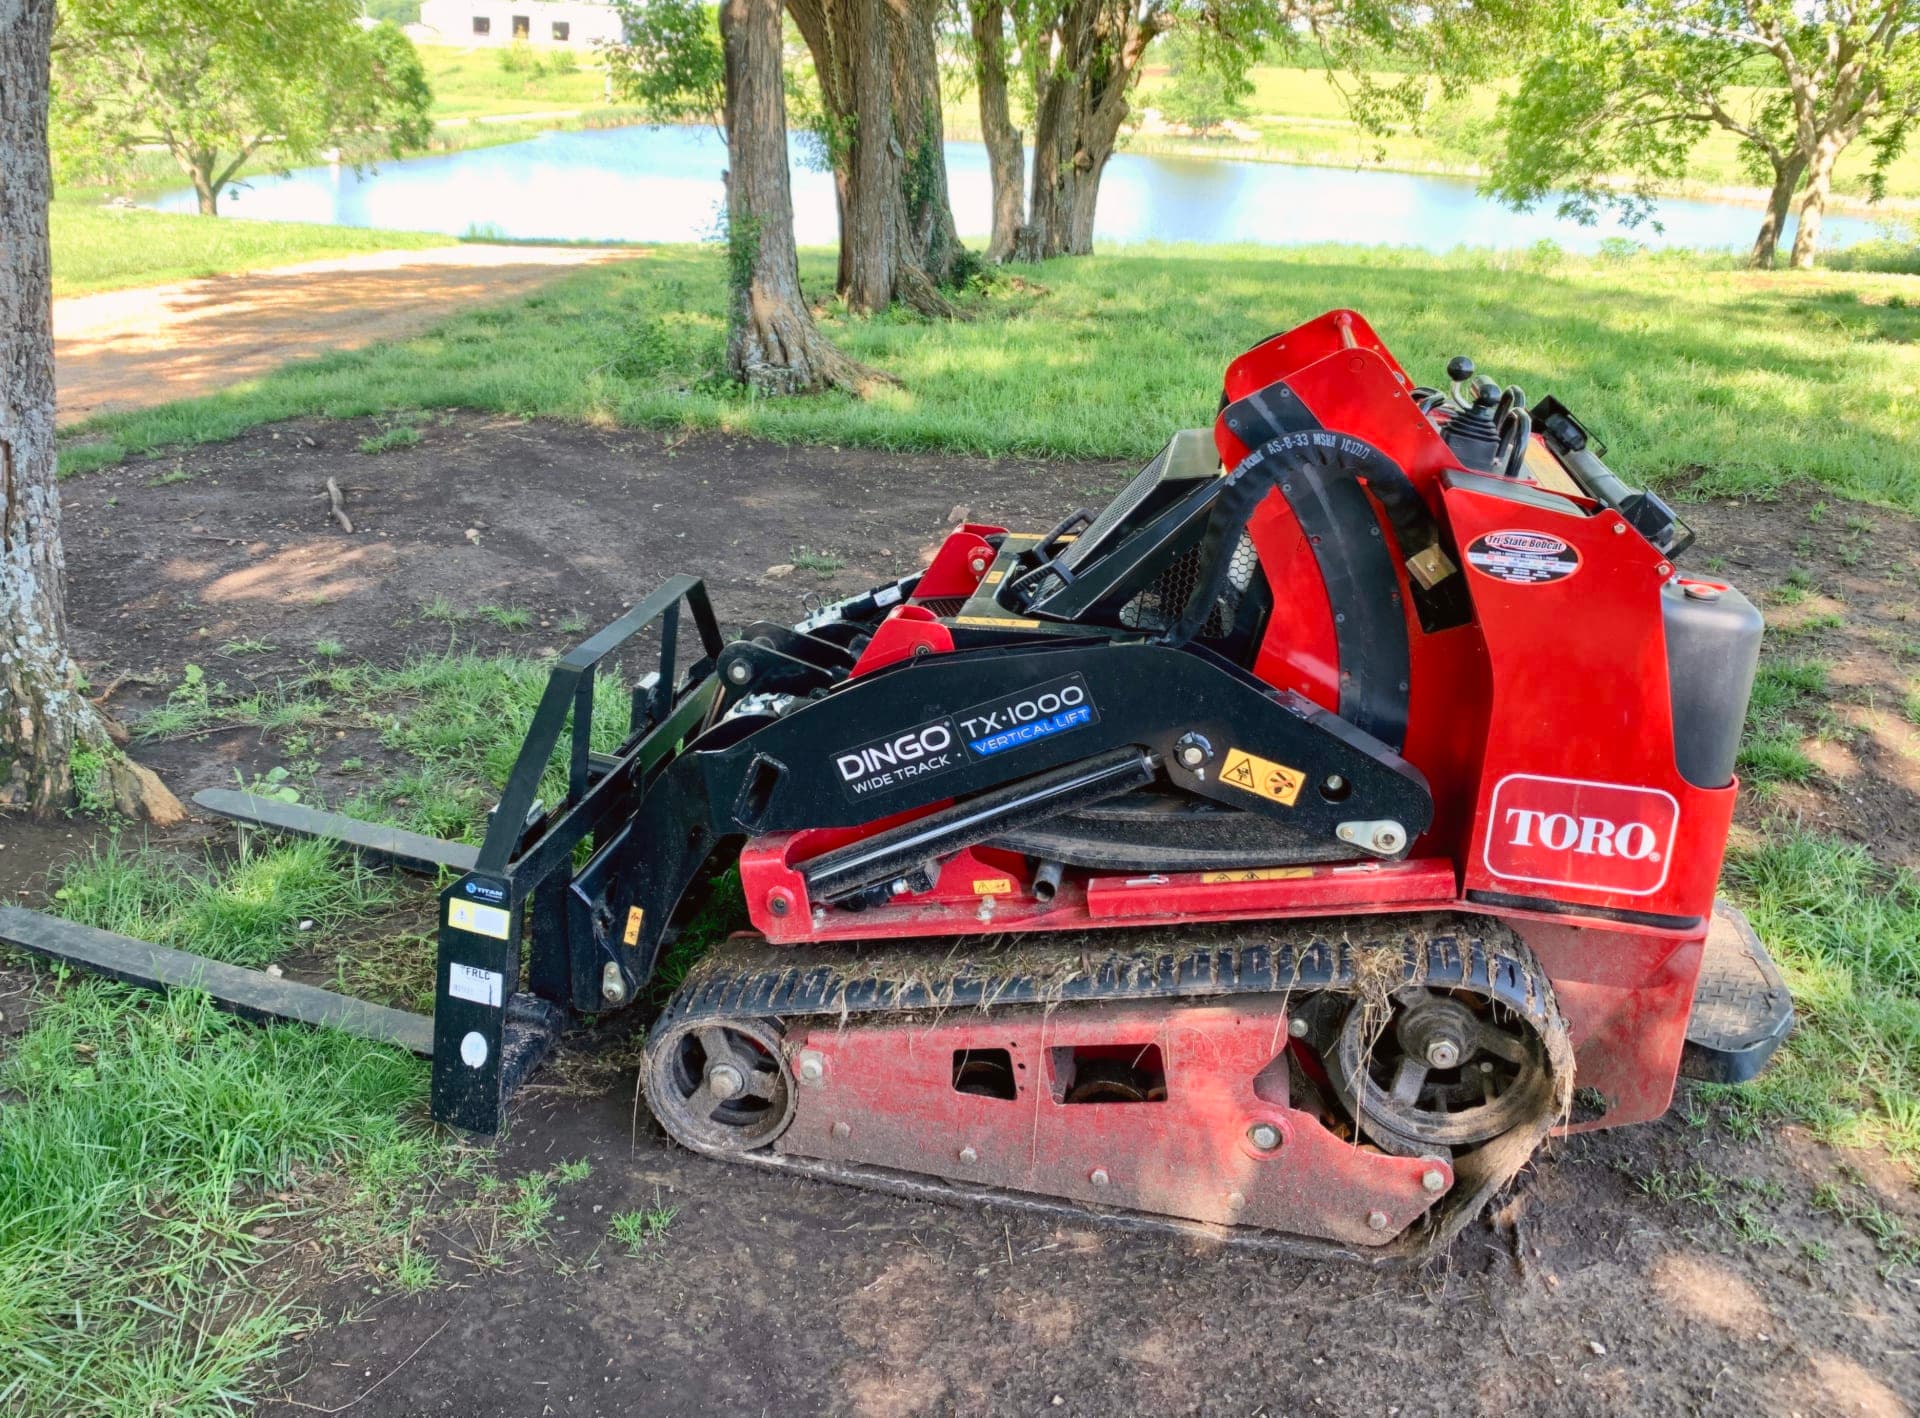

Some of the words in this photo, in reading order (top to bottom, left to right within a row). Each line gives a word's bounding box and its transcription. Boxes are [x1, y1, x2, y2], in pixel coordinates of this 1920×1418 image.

[1529, 539, 1563, 551] Bobcat
[836, 725, 951, 781] DINGO
[975, 722, 1054, 753] VERTICAL
[1056, 709, 1089, 729] LIFT
[852, 775, 894, 794] WIDE
[896, 754, 951, 780] TRACK
[1505, 808, 1657, 860] TORO
